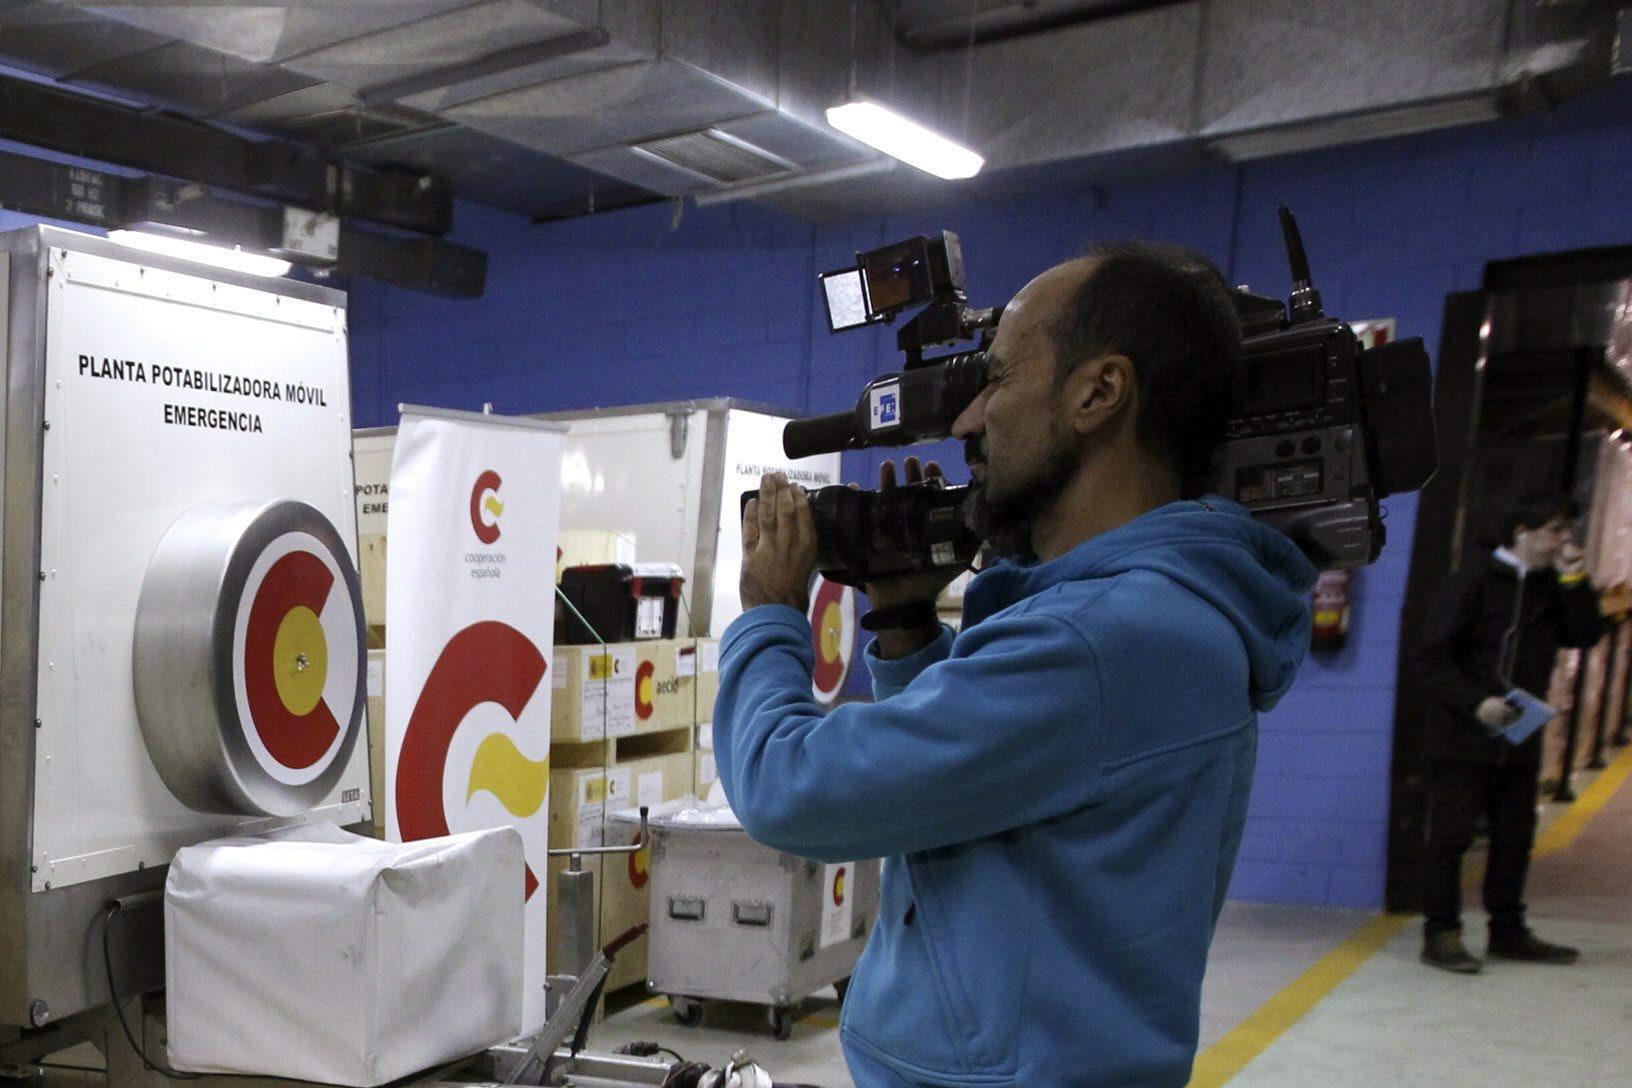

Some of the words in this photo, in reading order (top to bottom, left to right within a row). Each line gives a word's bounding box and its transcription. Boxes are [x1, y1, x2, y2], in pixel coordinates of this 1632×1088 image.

[78, 354, 147, 383] PLANTA
[151, 364, 282, 401] POTABILIZADORA
[286, 381, 327, 407] MÓVIL
[164, 404, 263, 433] EMERGENCIA
